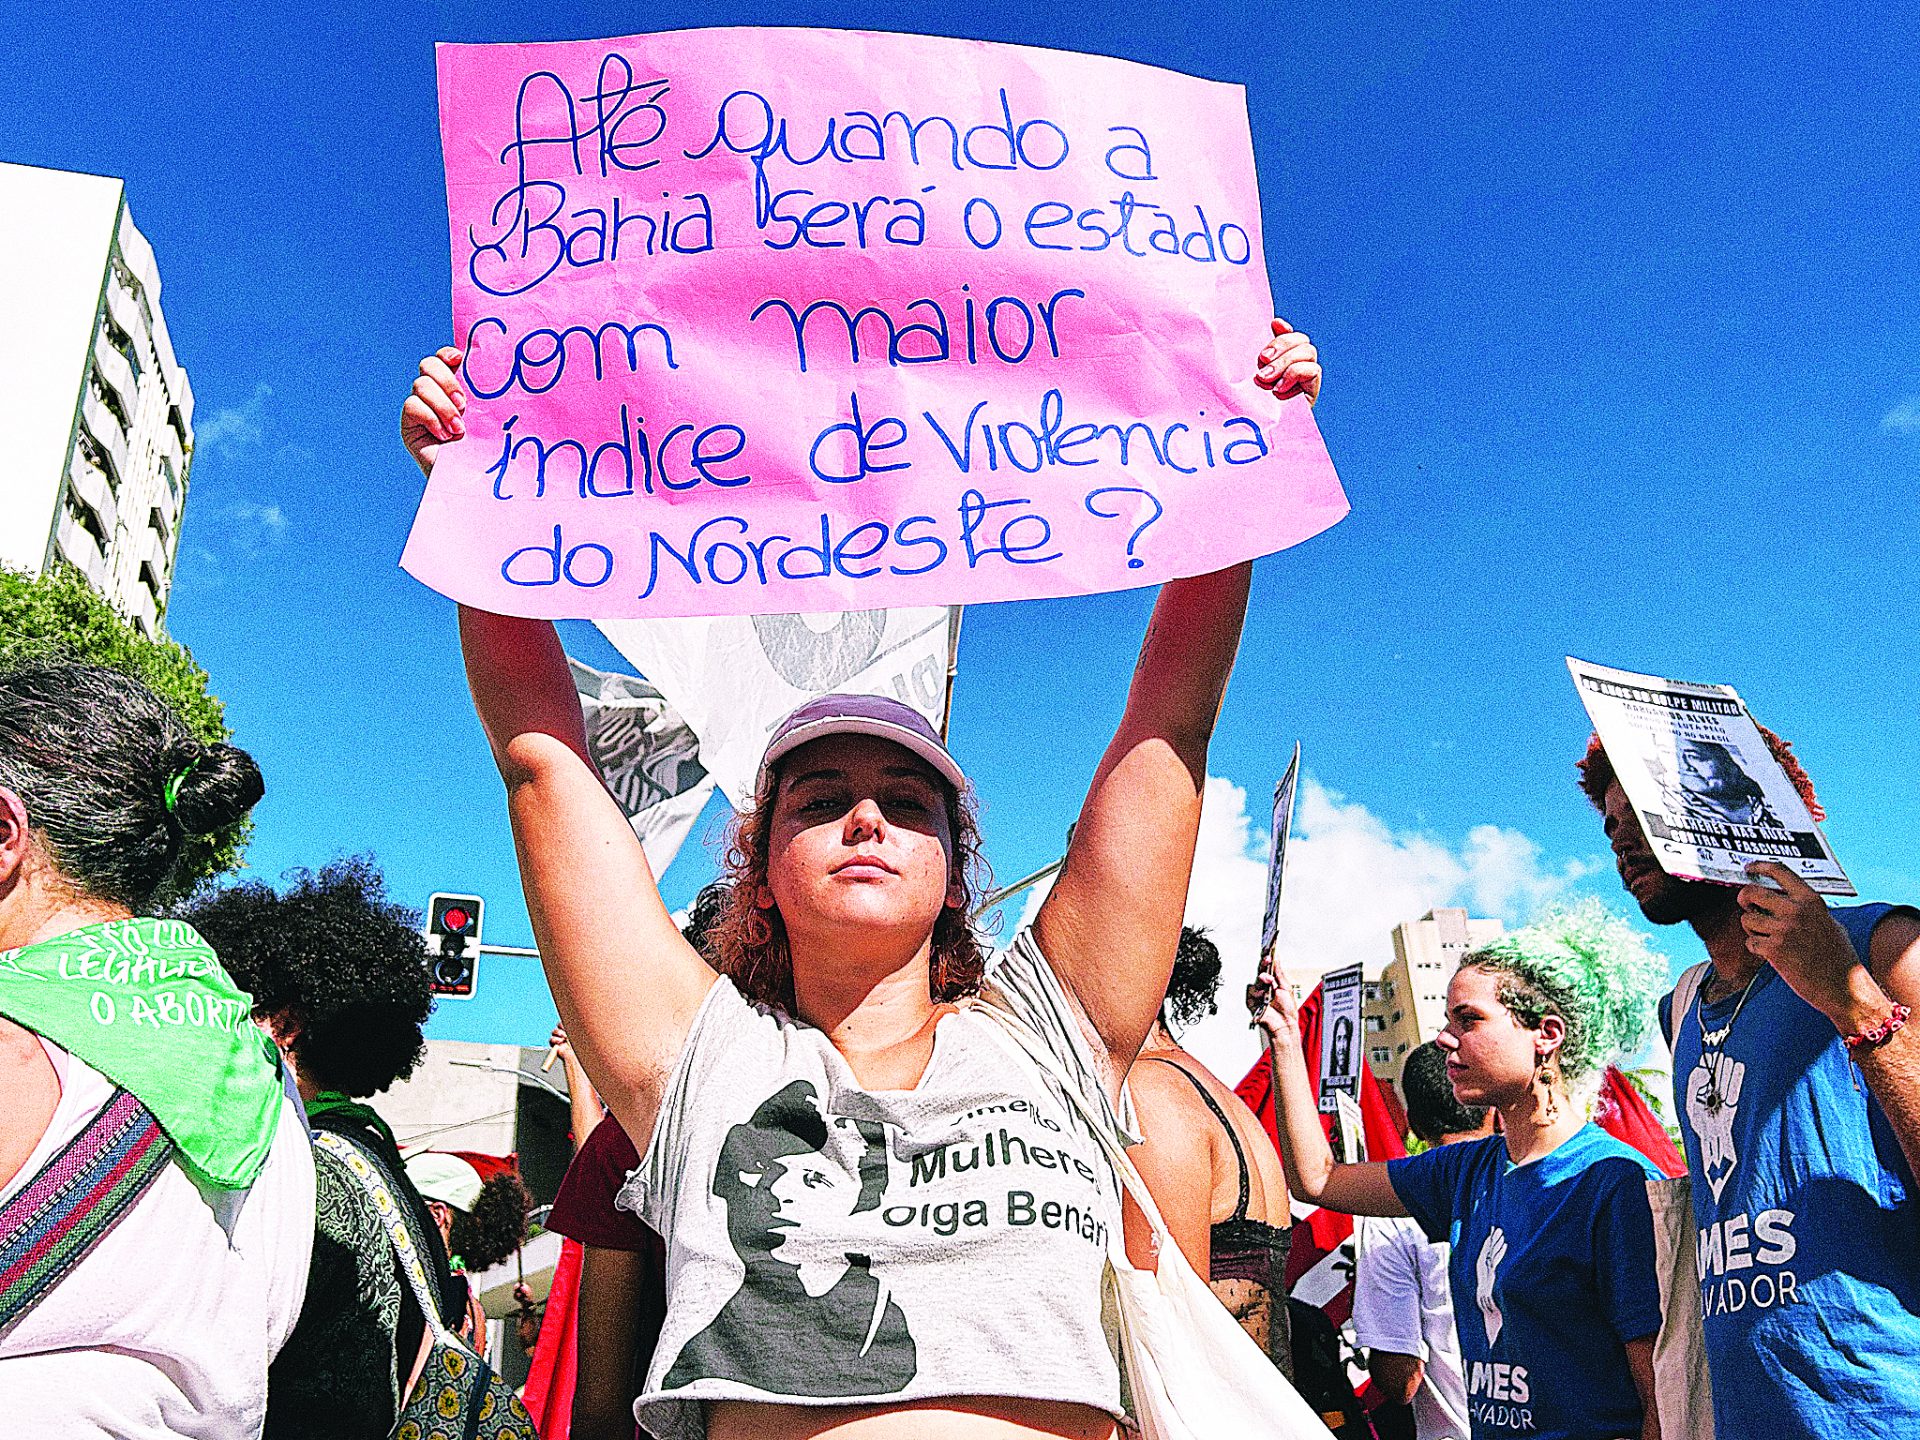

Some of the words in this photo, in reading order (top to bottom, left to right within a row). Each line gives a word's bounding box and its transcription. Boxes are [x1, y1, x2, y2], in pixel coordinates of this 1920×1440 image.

[501, 53, 670, 178] Até
[683, 88, 1070, 230] quando
[1105, 126, 1158, 181] a
[469, 180, 714, 297] Bahia
[764, 184, 937, 250] será
[963, 197, 1002, 250] o
[1024, 190, 1251, 265] estado
[750, 284, 1085, 373] maior
[485, 404, 752, 501] índice
[809, 391, 912, 484] de
[501, 523, 614, 588] do
[1685, 713, 1720, 725] ALVES
[1691, 699, 1740, 715] MILITAR
[1661, 814, 1728, 835] MULHERES
[1729, 823, 1759, 840] NAS
[1671, 829, 1721, 848] CONTRA
[1722, 838, 1733, 850] O
[1735, 839, 1802, 857] FASCISMO
[90, 991, 116, 1026] O
[1695, 1209, 1797, 1282] MES
